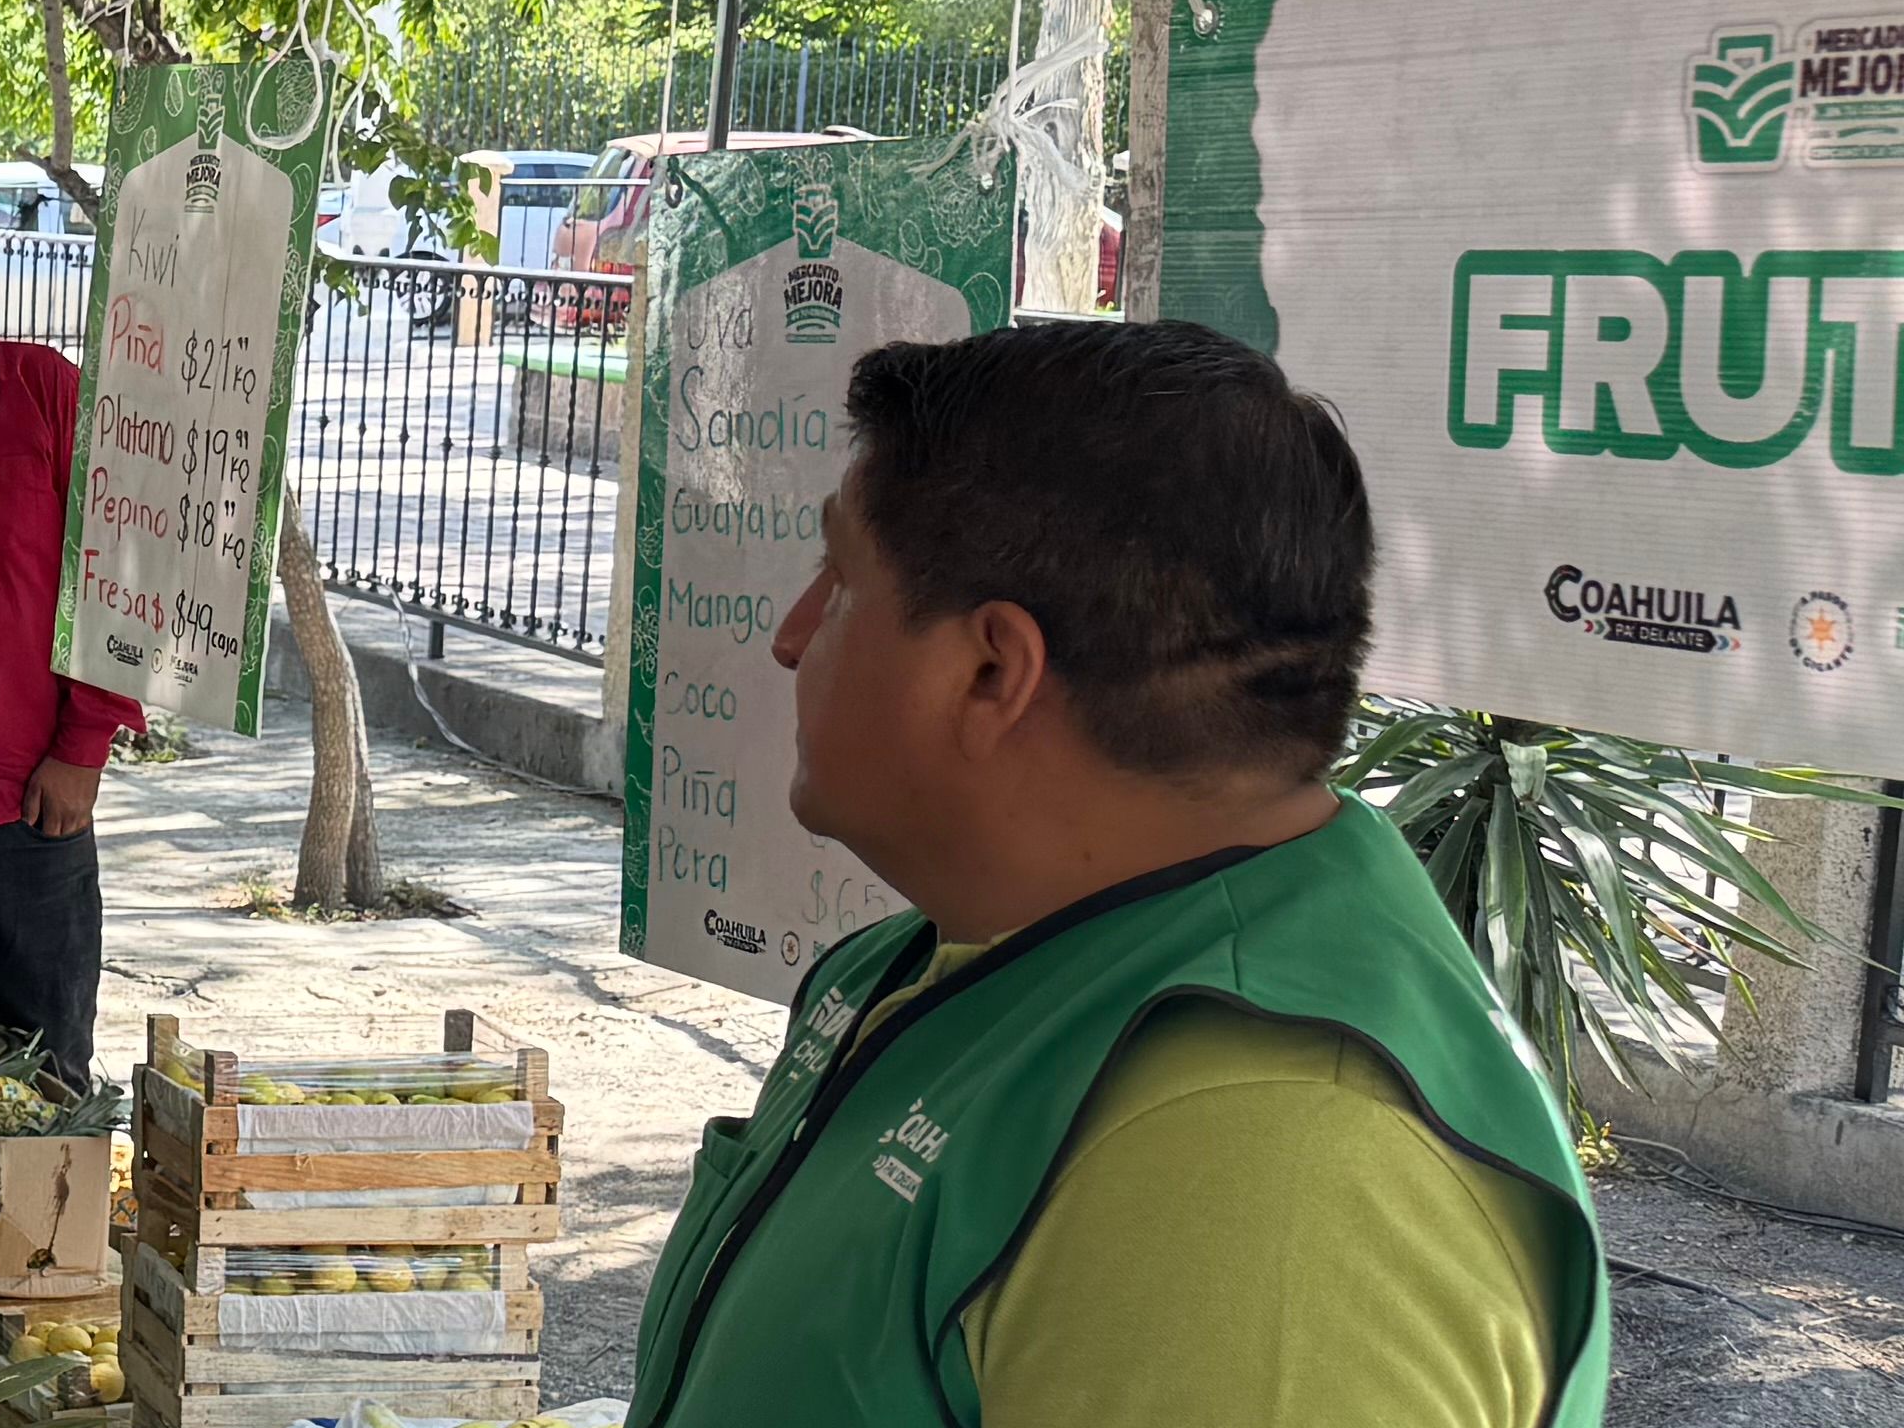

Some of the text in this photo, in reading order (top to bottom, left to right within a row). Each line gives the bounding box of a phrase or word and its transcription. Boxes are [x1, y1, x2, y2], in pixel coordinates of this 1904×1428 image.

[783, 279, 843, 311] MEJORA
[94, 393, 175, 466] Platano
[675, 365, 827, 454] Sandía
[91, 466, 169, 542] Pepino
[671, 486, 821, 548] Guayaba
[668, 577, 775, 645] Mango
[1543, 563, 1742, 631] COAHUILA
[1640, 626, 1706, 648] DELANTE
[662, 744, 737, 829] Piña
[657, 824, 728, 894] Pera
[704, 908, 767, 947] COAHUILA
